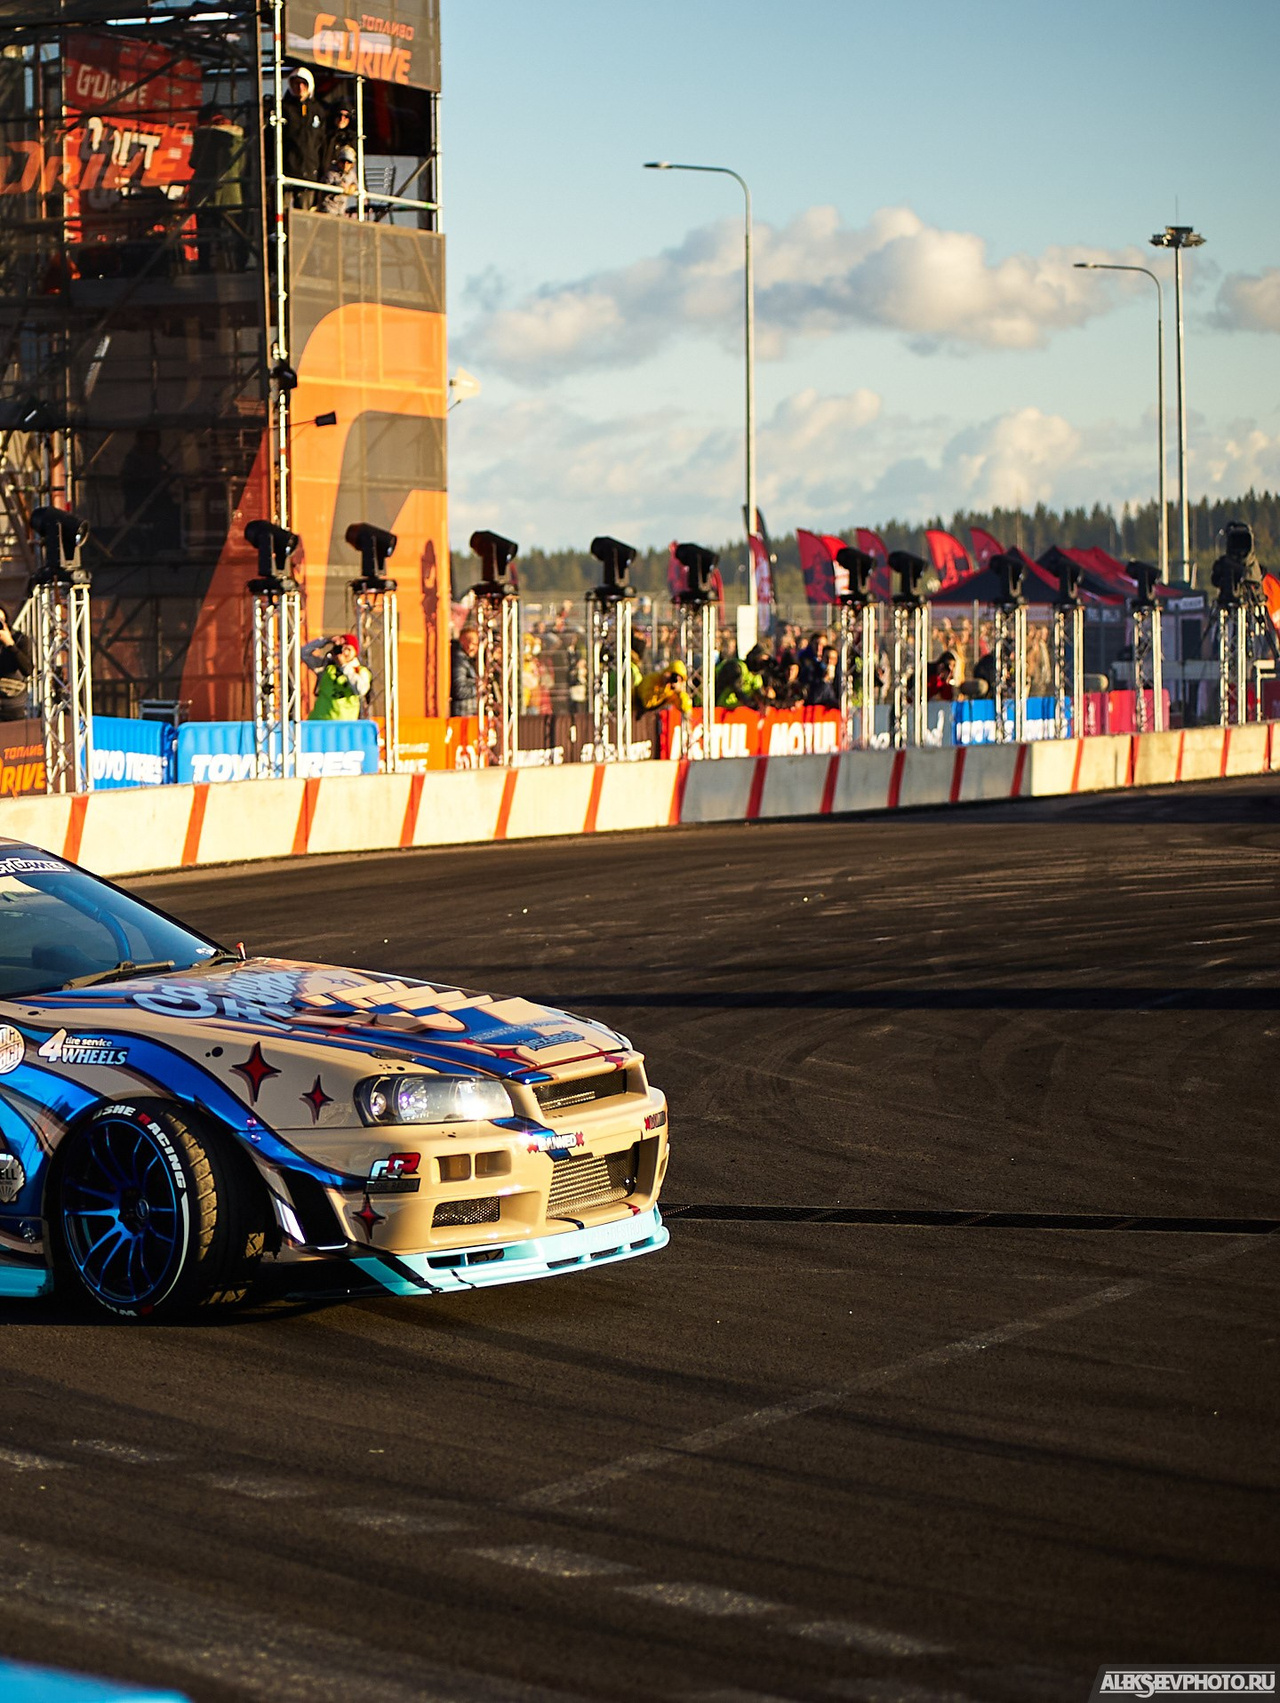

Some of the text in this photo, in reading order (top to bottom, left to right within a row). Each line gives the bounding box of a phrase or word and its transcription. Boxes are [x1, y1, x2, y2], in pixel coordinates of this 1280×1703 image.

[769, 721, 839, 757] MOTUL
[39, 1028, 67, 1062] 4
[62, 1048, 127, 1065] WHEELS
[66, 1036, 112, 1047] tire service
[137, 1112, 186, 1189] RACING
